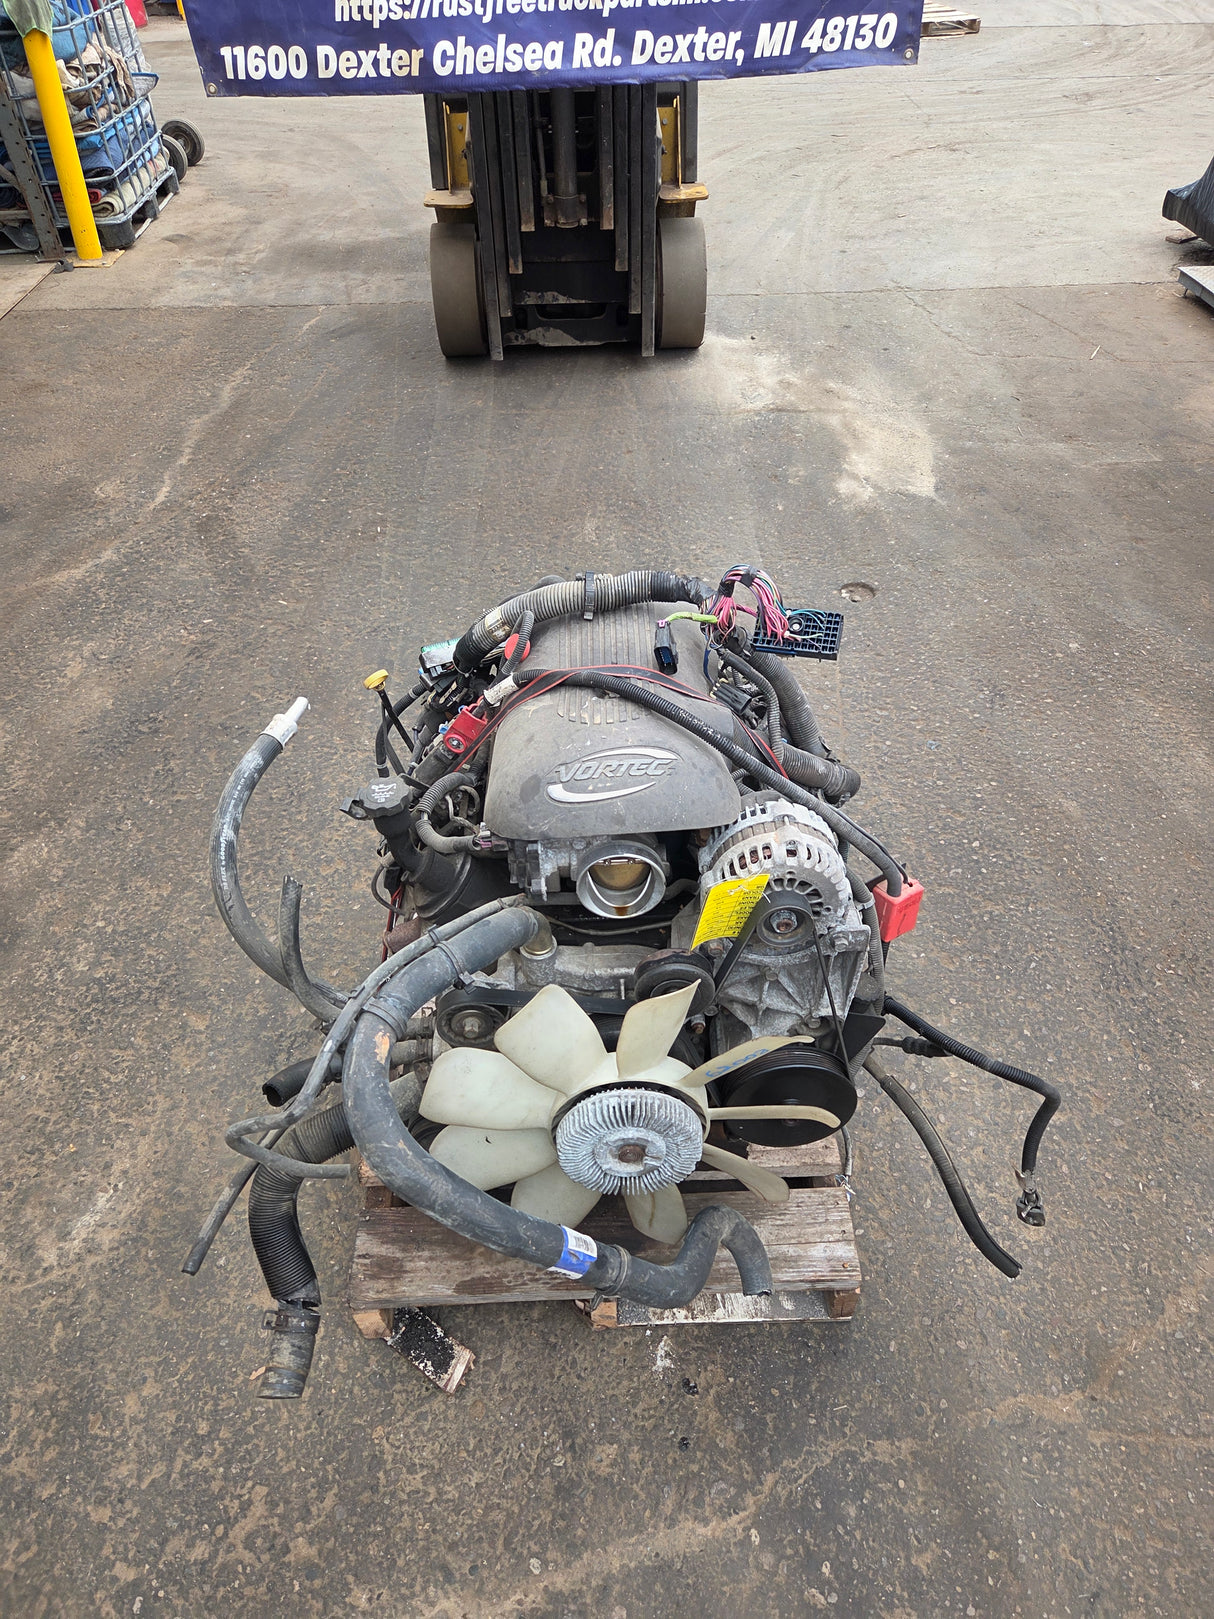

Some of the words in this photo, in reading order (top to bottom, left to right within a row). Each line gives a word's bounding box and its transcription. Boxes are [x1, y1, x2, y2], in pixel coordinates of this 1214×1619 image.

[220, 45, 308, 80] 11600
[317, 43, 424, 79] Dexter
[433, 34, 564, 76] Chelsea
[572, 28, 622, 68] Rd.
[631, 26, 745, 66] Dexter,
[754, 20, 798, 58] MI
[801, 13, 898, 54] 48130
[556, 758, 674, 783] VORTEC
